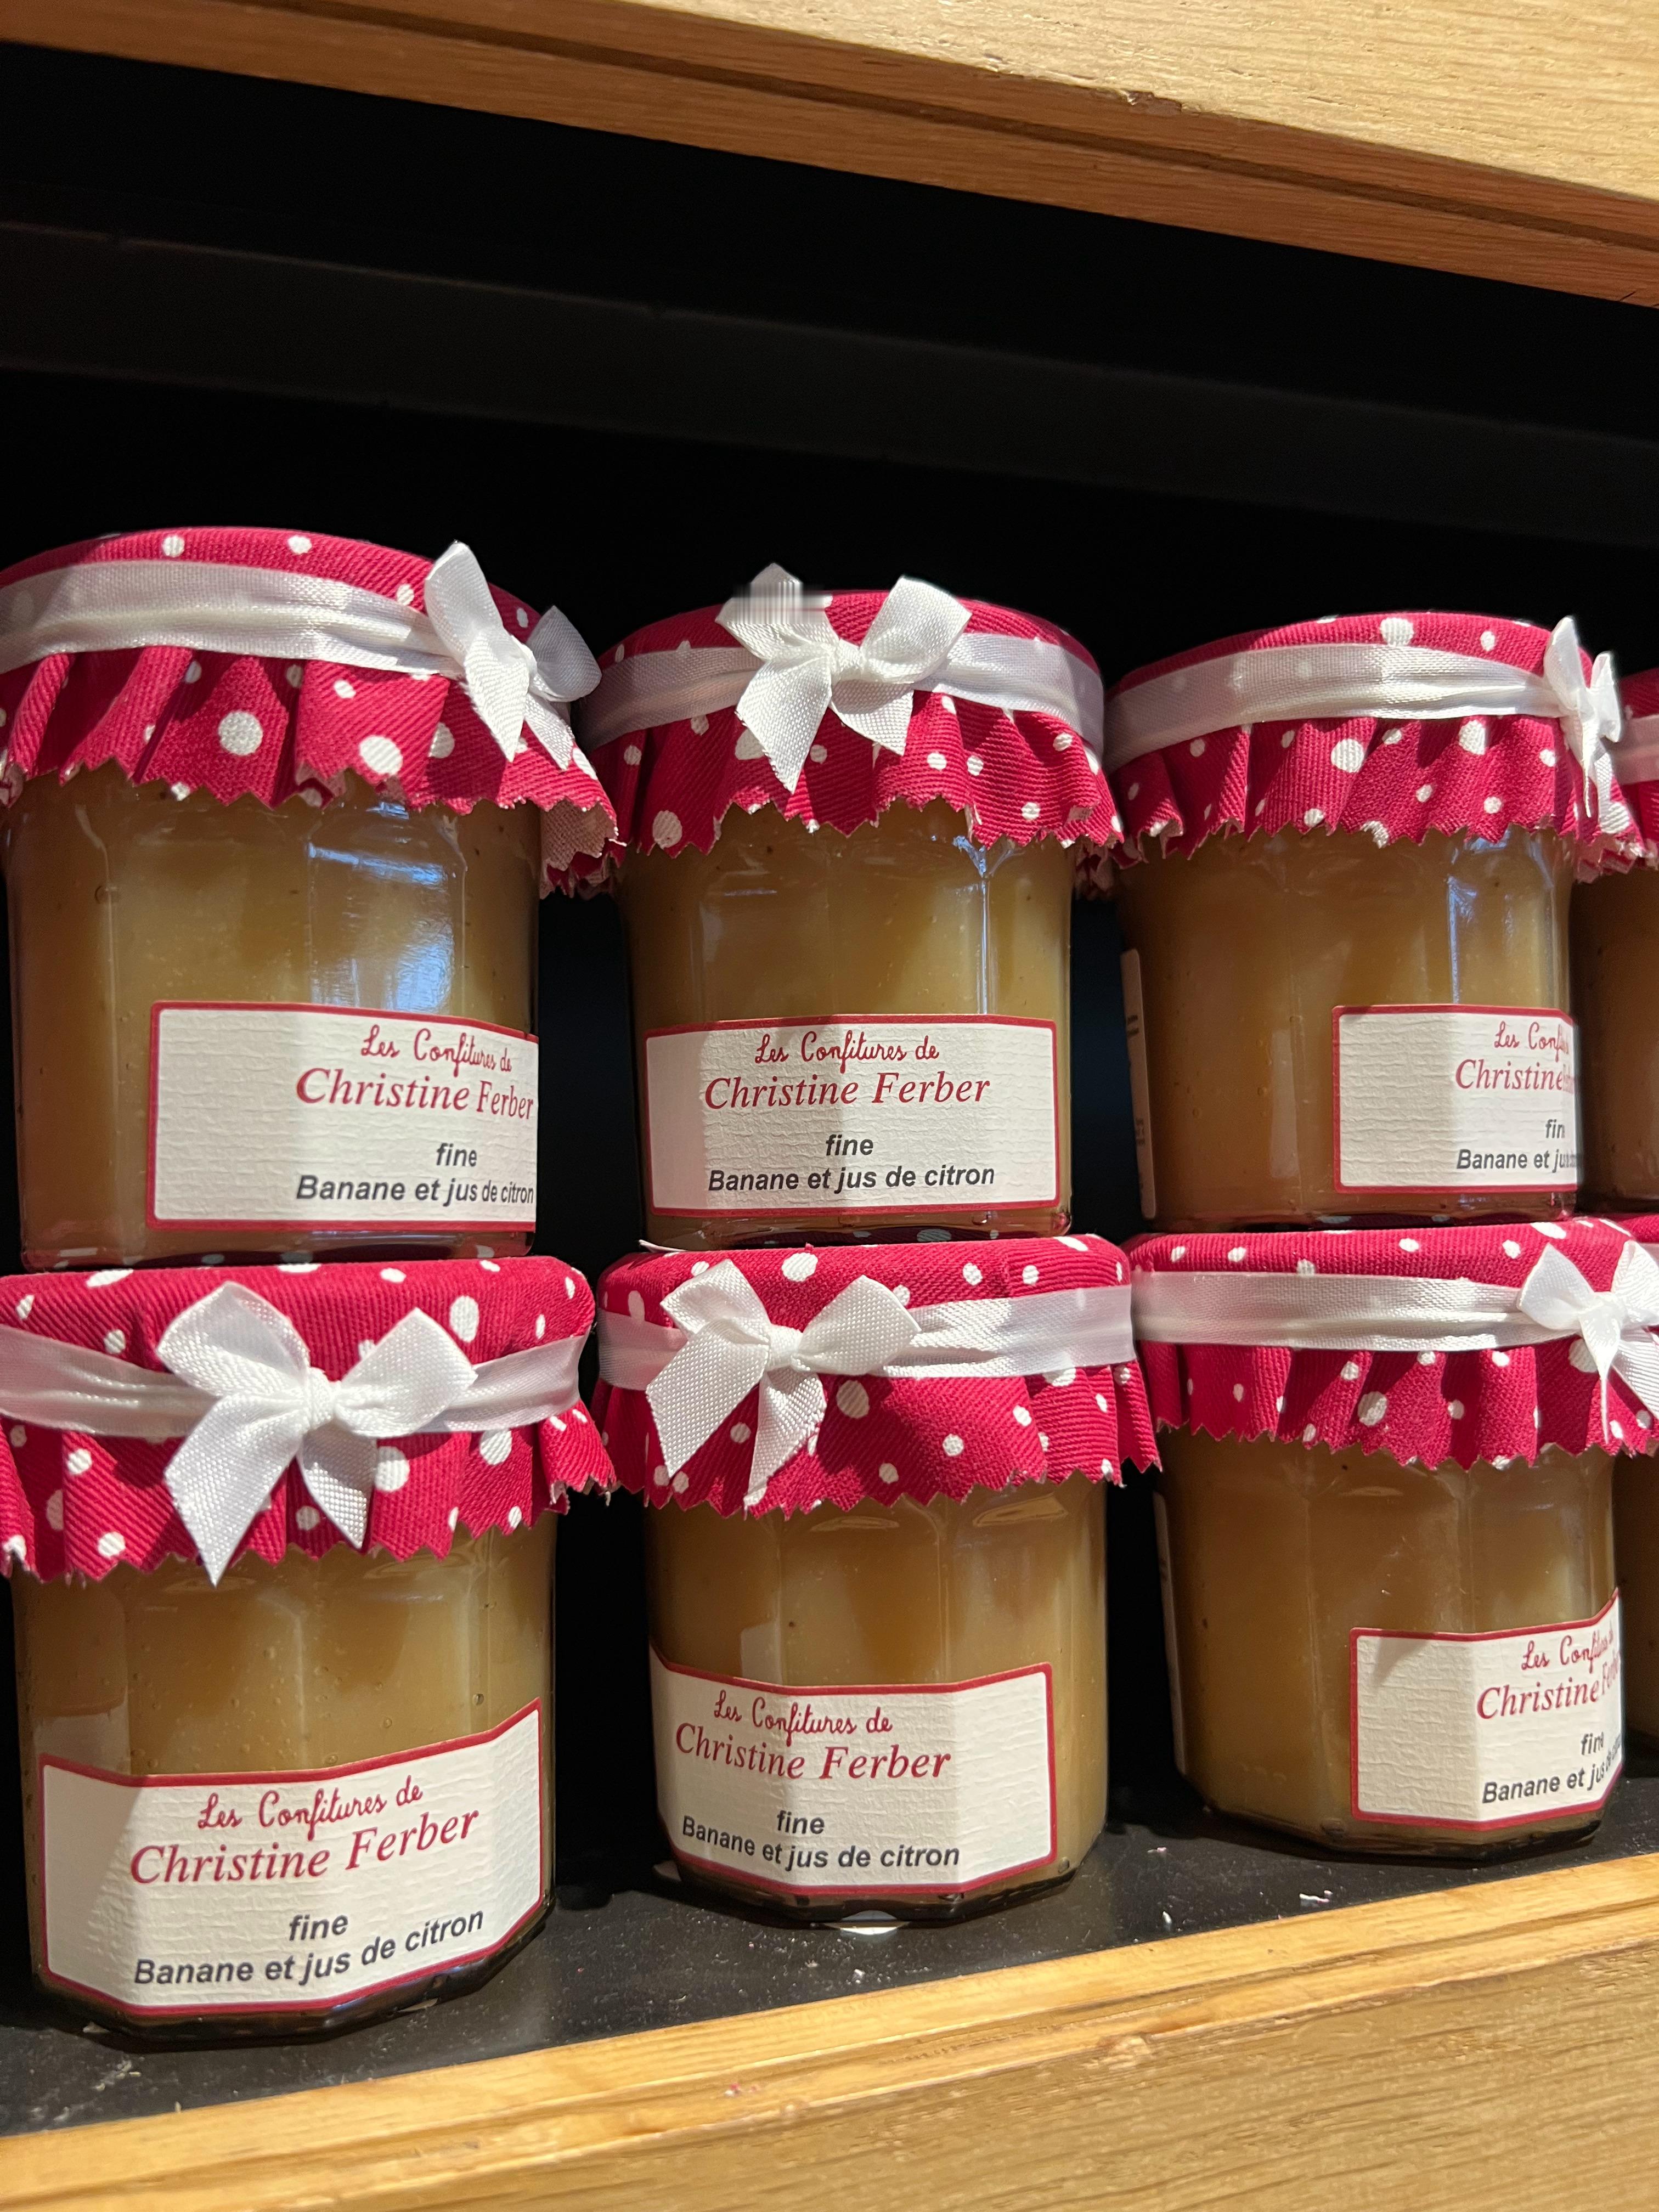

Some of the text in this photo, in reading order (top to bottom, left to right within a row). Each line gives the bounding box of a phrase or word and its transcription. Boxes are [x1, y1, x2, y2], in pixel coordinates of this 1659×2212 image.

[361, 1024, 512, 1077] Les Confitures de
[755, 1030, 940, 1074] Les Confitures de
[1494, 1020, 1520, 1048] Les
[296, 1067, 533, 1119] Christine Ferber
[704, 1071, 990, 1109] Christine Ferber
[825, 1134, 874, 1156] fine
[1545, 1119, 1565, 1138] fin
[436, 1143, 477, 1166] fine
[1457, 1149, 1527, 1170] Banane
[1534, 1150, 1550, 1169] et
[296, 1174, 534, 1207] Banane et jus de citron
[708, 1164, 995, 1194] Banane et jus de citron
[1521, 1640, 1549, 1671] Les
[1476, 1676, 1599, 1719] Christine
[714, 1689, 893, 1746] Les Confitures de
[675, 1722, 951, 1780] Christine Ferber
[1482, 1774, 1560, 1804] Banane
[1567, 1767, 1585, 1788] et
[198, 1775, 423, 1841] Les Confitures de
[777, 1810, 825, 1835] fine
[130, 1809, 481, 1884] Christine Ferber
[682, 1815, 960, 1871] Banane et jus de citron
[289, 1914, 349, 1942] fine
[134, 1910, 484, 1986] Banane et jus de citron
